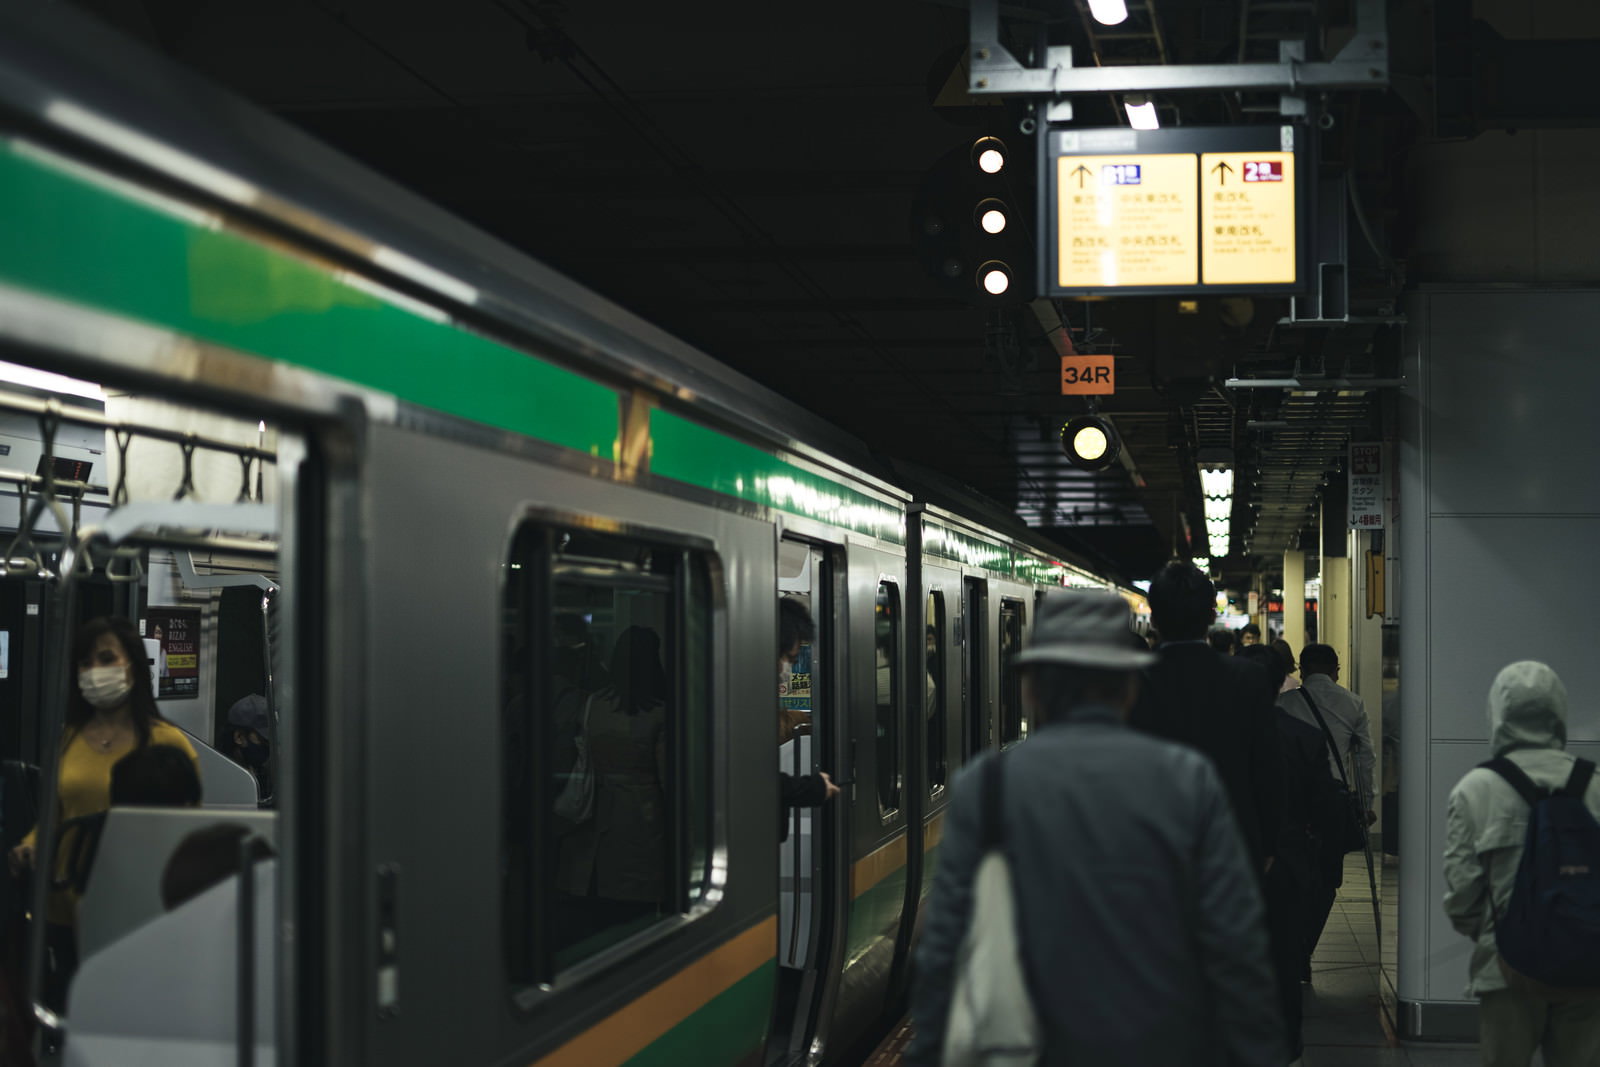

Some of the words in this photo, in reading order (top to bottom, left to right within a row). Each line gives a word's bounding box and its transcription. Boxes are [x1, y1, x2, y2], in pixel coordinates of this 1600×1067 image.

[1064, 366, 1110, 384] 34R
[1353, 447, 1378, 456] STOP
[1352, 487, 1374, 495] ボタン
